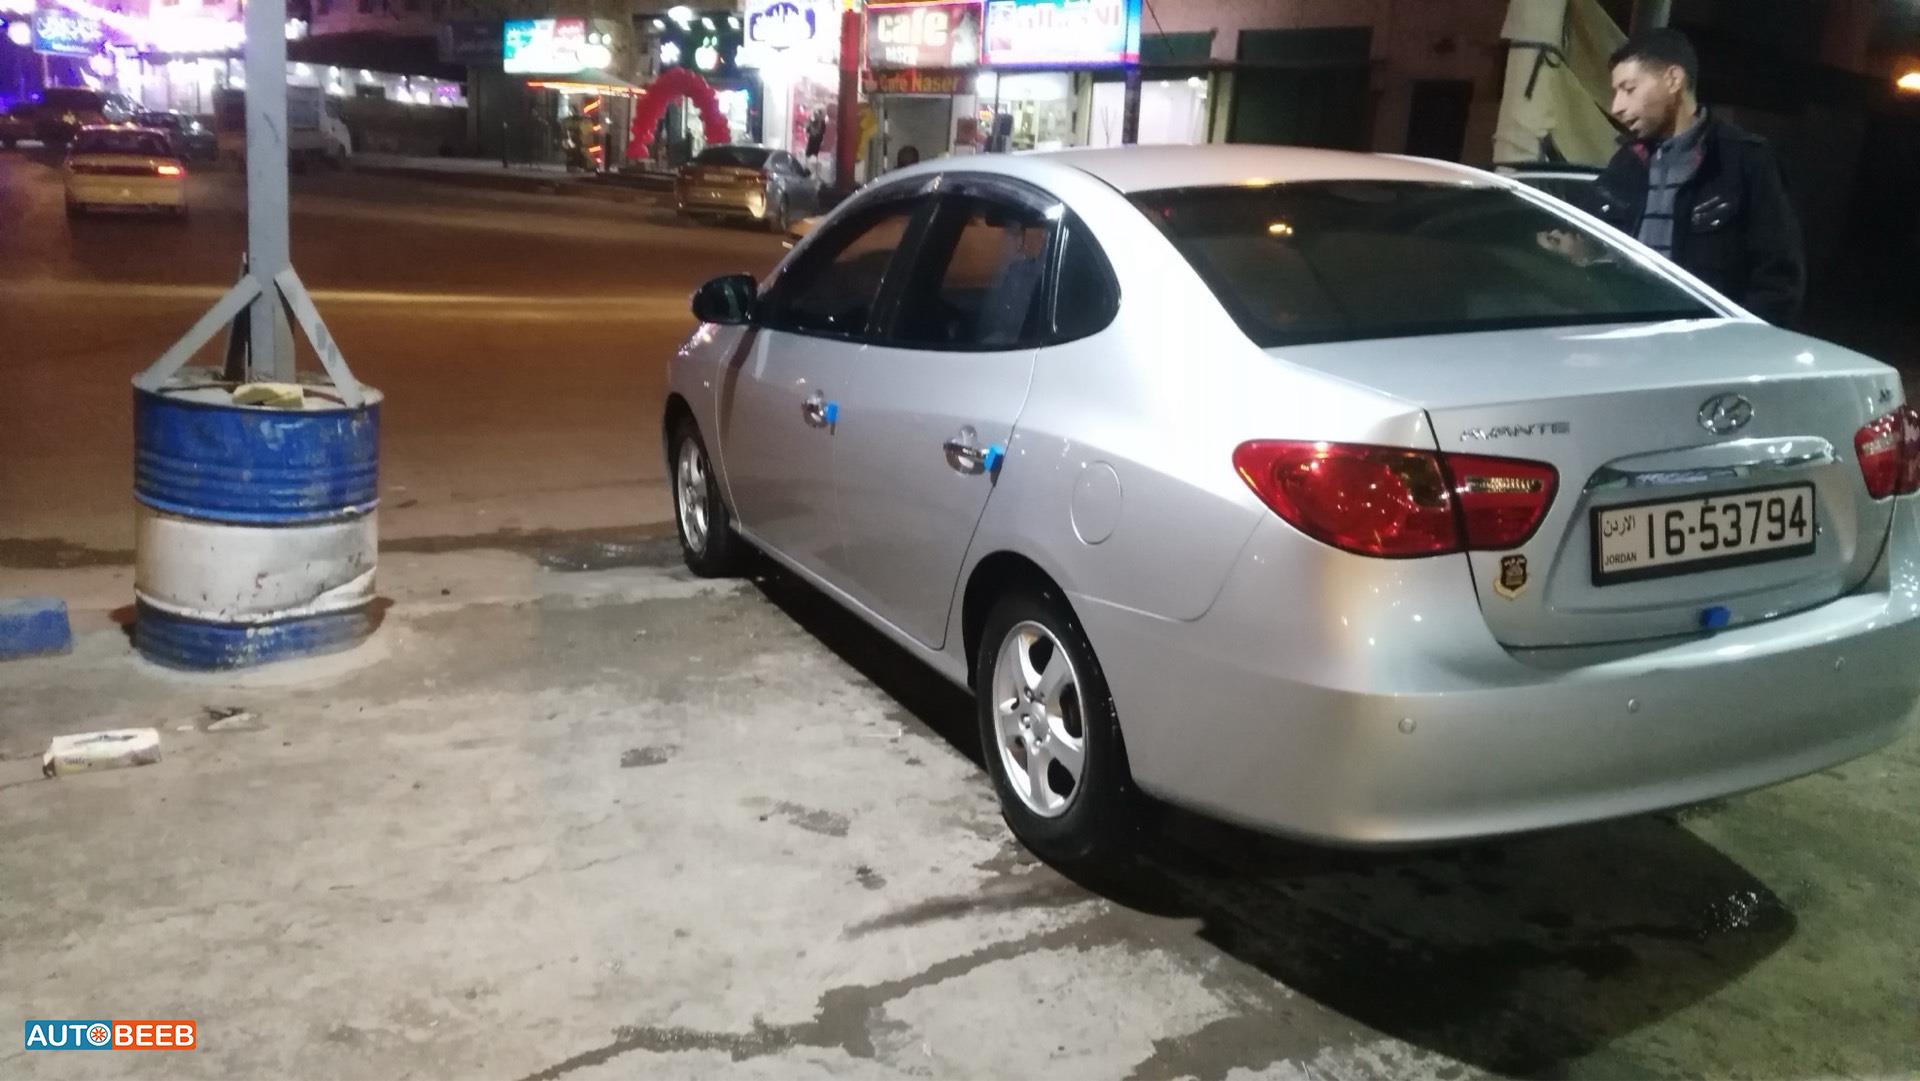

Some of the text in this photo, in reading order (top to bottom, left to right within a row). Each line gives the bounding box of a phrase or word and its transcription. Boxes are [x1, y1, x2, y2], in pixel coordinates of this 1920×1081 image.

[878, 7, 948, 46] cafe
[1459, 421, 1570, 442] AVANTE
[1604, 551, 1637, 566] JORDAN
